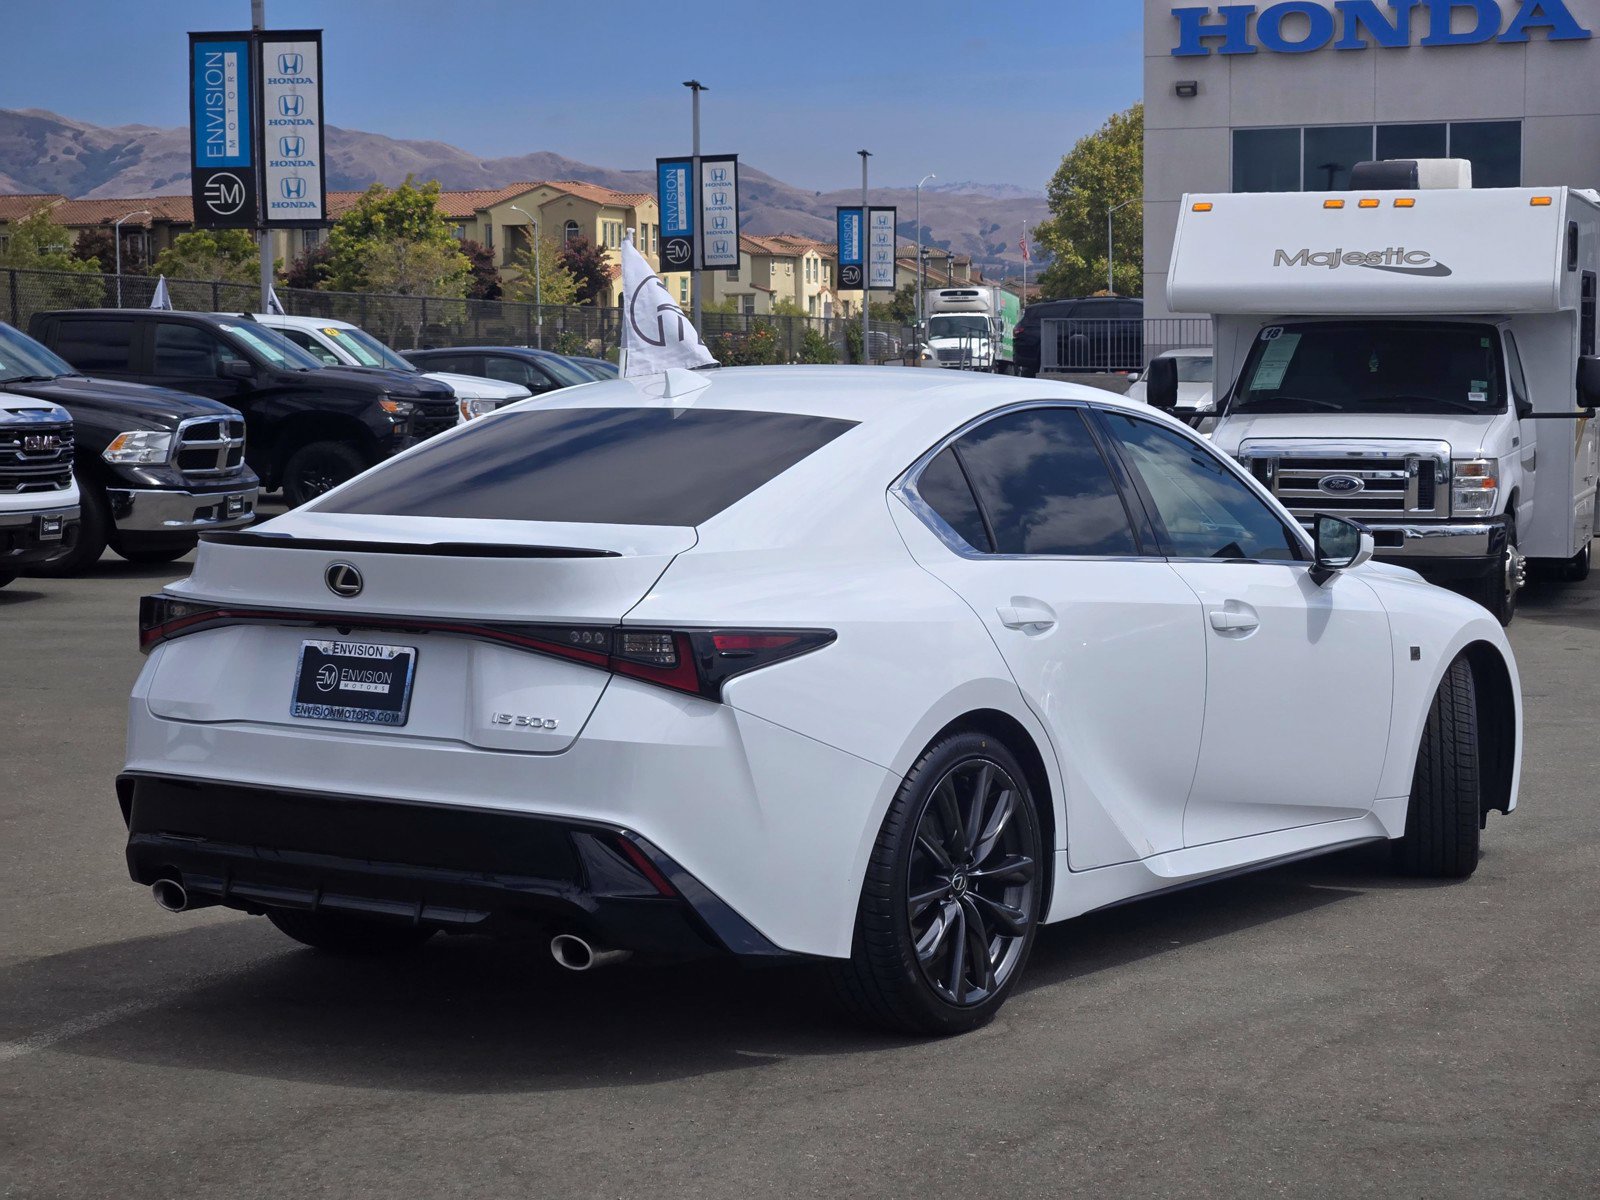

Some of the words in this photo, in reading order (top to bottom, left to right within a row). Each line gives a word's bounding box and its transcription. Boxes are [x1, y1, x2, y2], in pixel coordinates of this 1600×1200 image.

[1171, 0, 1592, 56] HONDA
[205, 52, 224, 158] ENVISION
[227, 61, 236, 148] MOTORS
[666, 169, 679, 231] ENVISION
[844, 214, 852, 260] ENVISION
[1273, 247, 1431, 269] Majestic
[25, 435, 61, 450] GMC
[333, 641, 384, 658] ENVISION
[341, 668, 393, 684] ENVISION
[344, 683, 386, 692] MOTORS
[295, 705, 401, 723] ENVISIONMOTORS.COM
[492, 712, 513, 725] IS
[515, 715, 560, 730] 300
